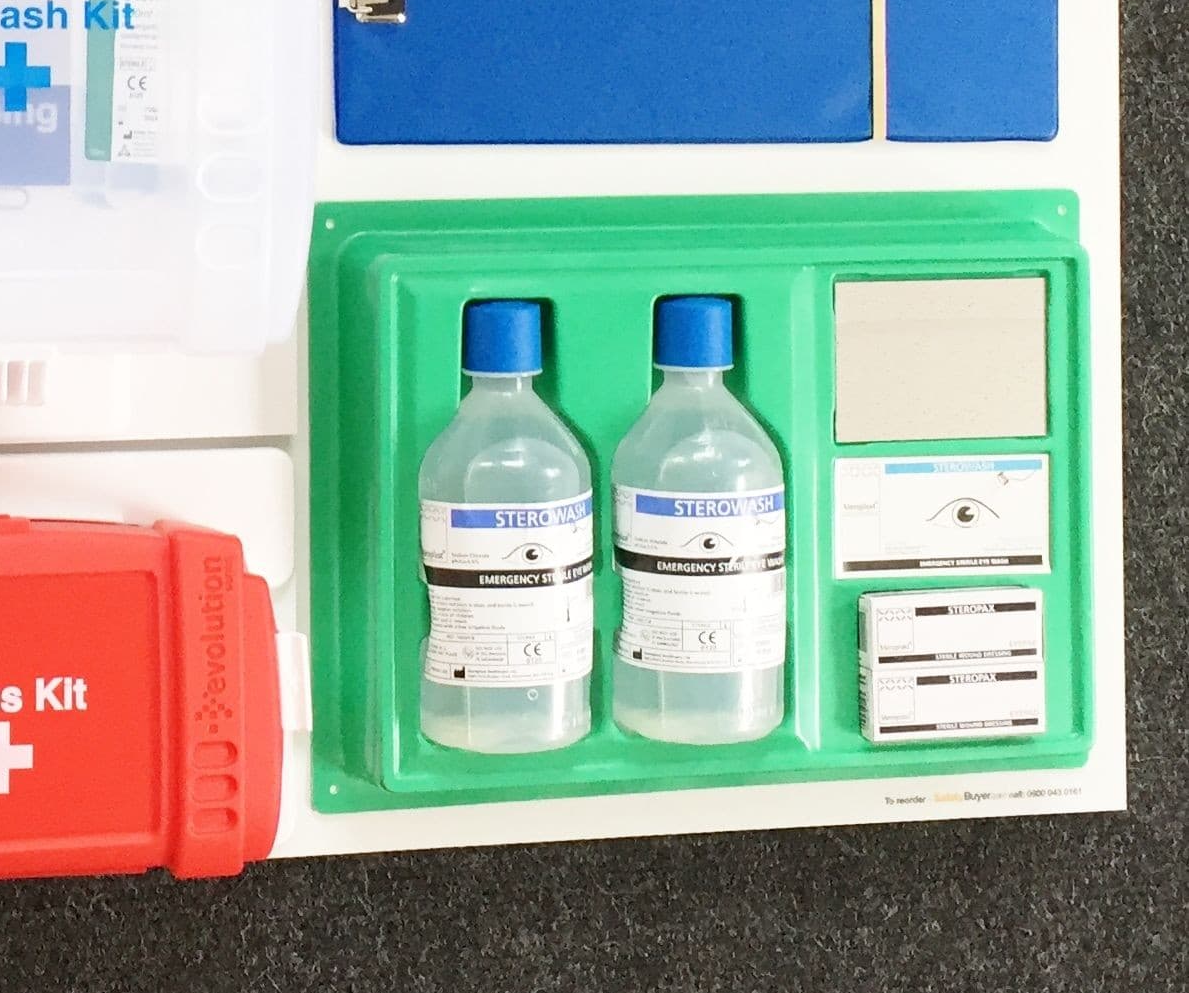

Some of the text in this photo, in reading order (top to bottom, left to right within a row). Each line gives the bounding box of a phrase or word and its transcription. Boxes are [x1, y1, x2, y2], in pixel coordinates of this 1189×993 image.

[84, 0, 135, 30] Kit
[495, 501, 587, 528] STEROWASH
[674, 495, 775, 517] STEROWASH
[657, 561, 716, 573] EMERGENCY
[479, 574, 541, 585] EMERGENCY
[947, 603, 997, 615] STEROPAX
[198, 556, 226, 695] evolution
[948, 672, 998, 684] STEROPAX
[35, 676, 88, 711] Kit
[885, 796, 895, 805] To
